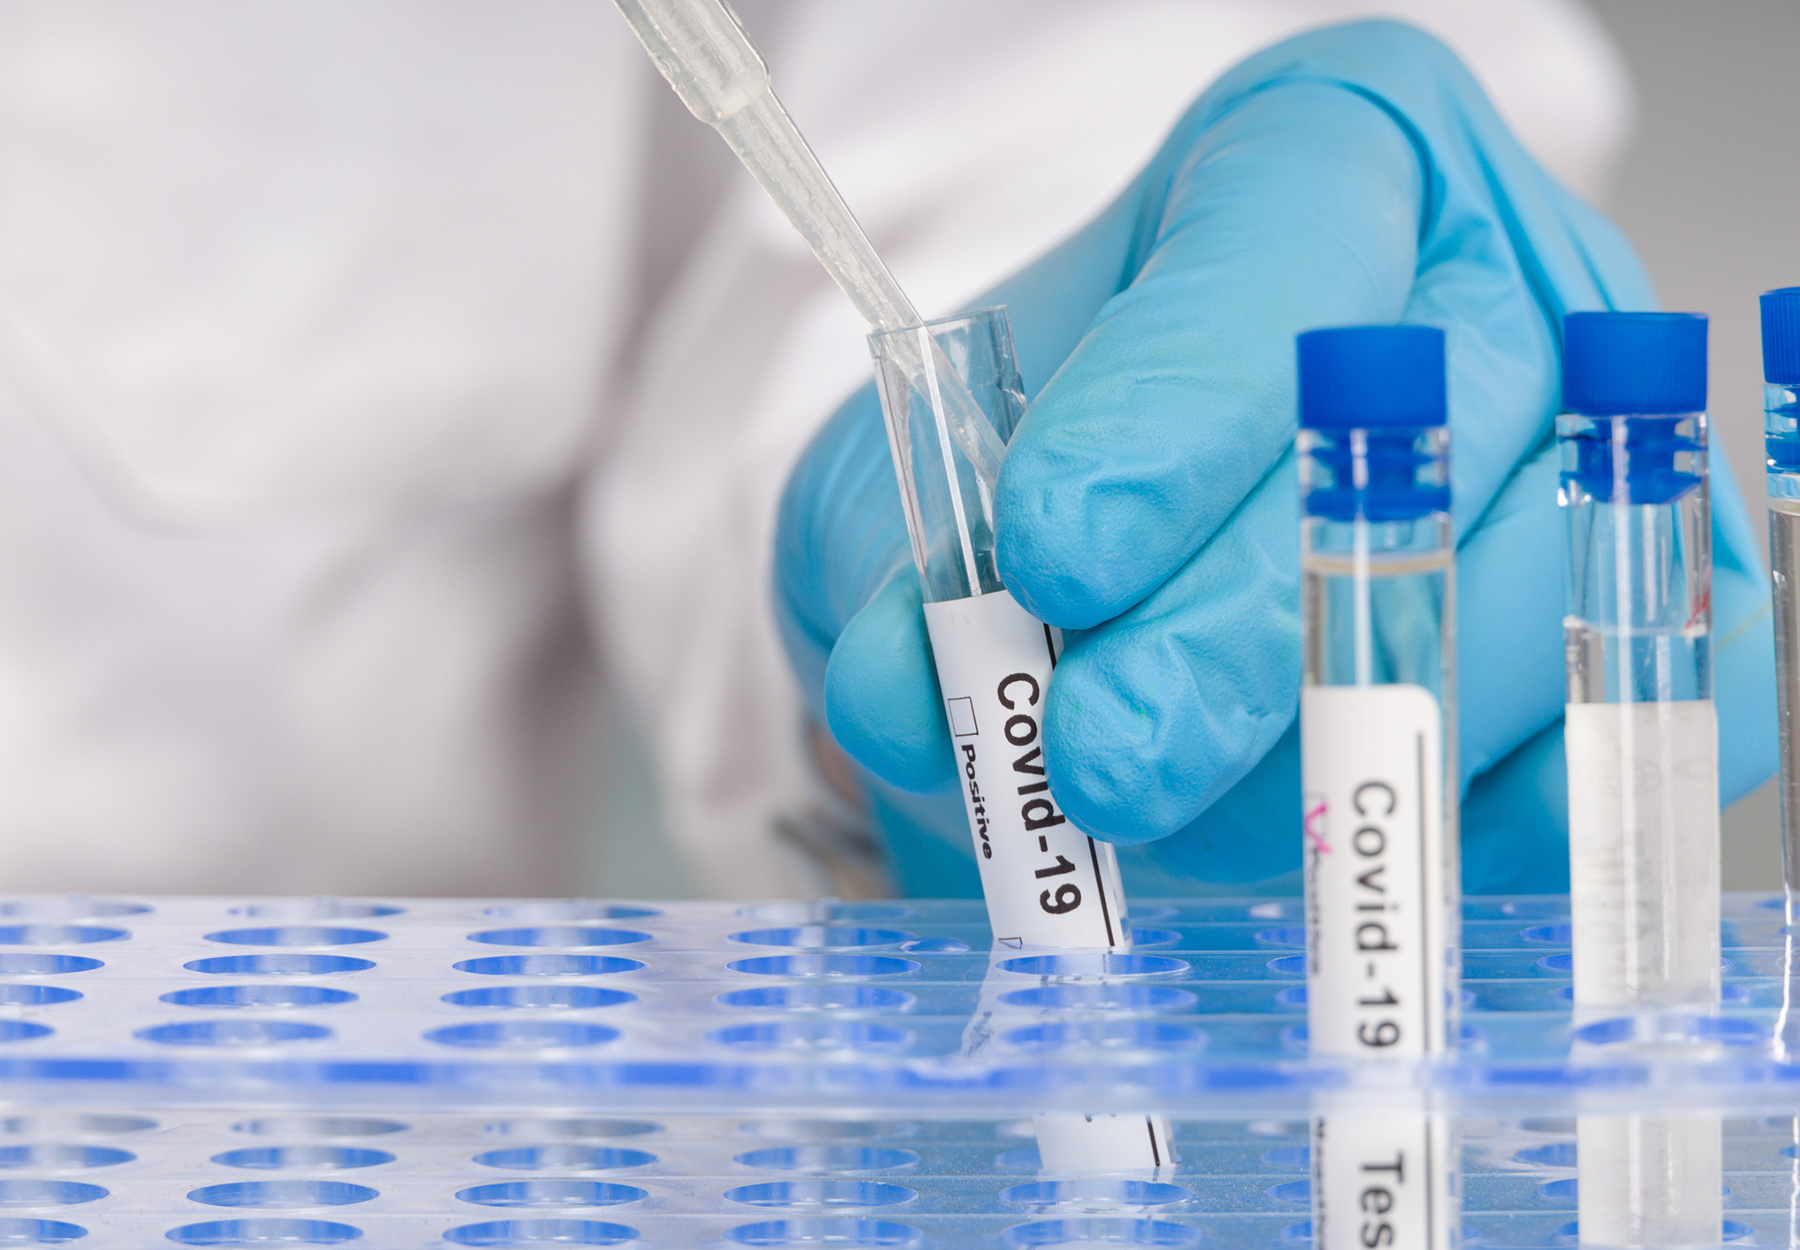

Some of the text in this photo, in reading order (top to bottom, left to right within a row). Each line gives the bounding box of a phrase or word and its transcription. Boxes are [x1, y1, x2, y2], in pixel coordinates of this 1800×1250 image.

[961, 744, 993, 860] Positive
[997, 672, 1082, 915] Covid-19
[1351, 779, 1401, 1049] Covid-19
